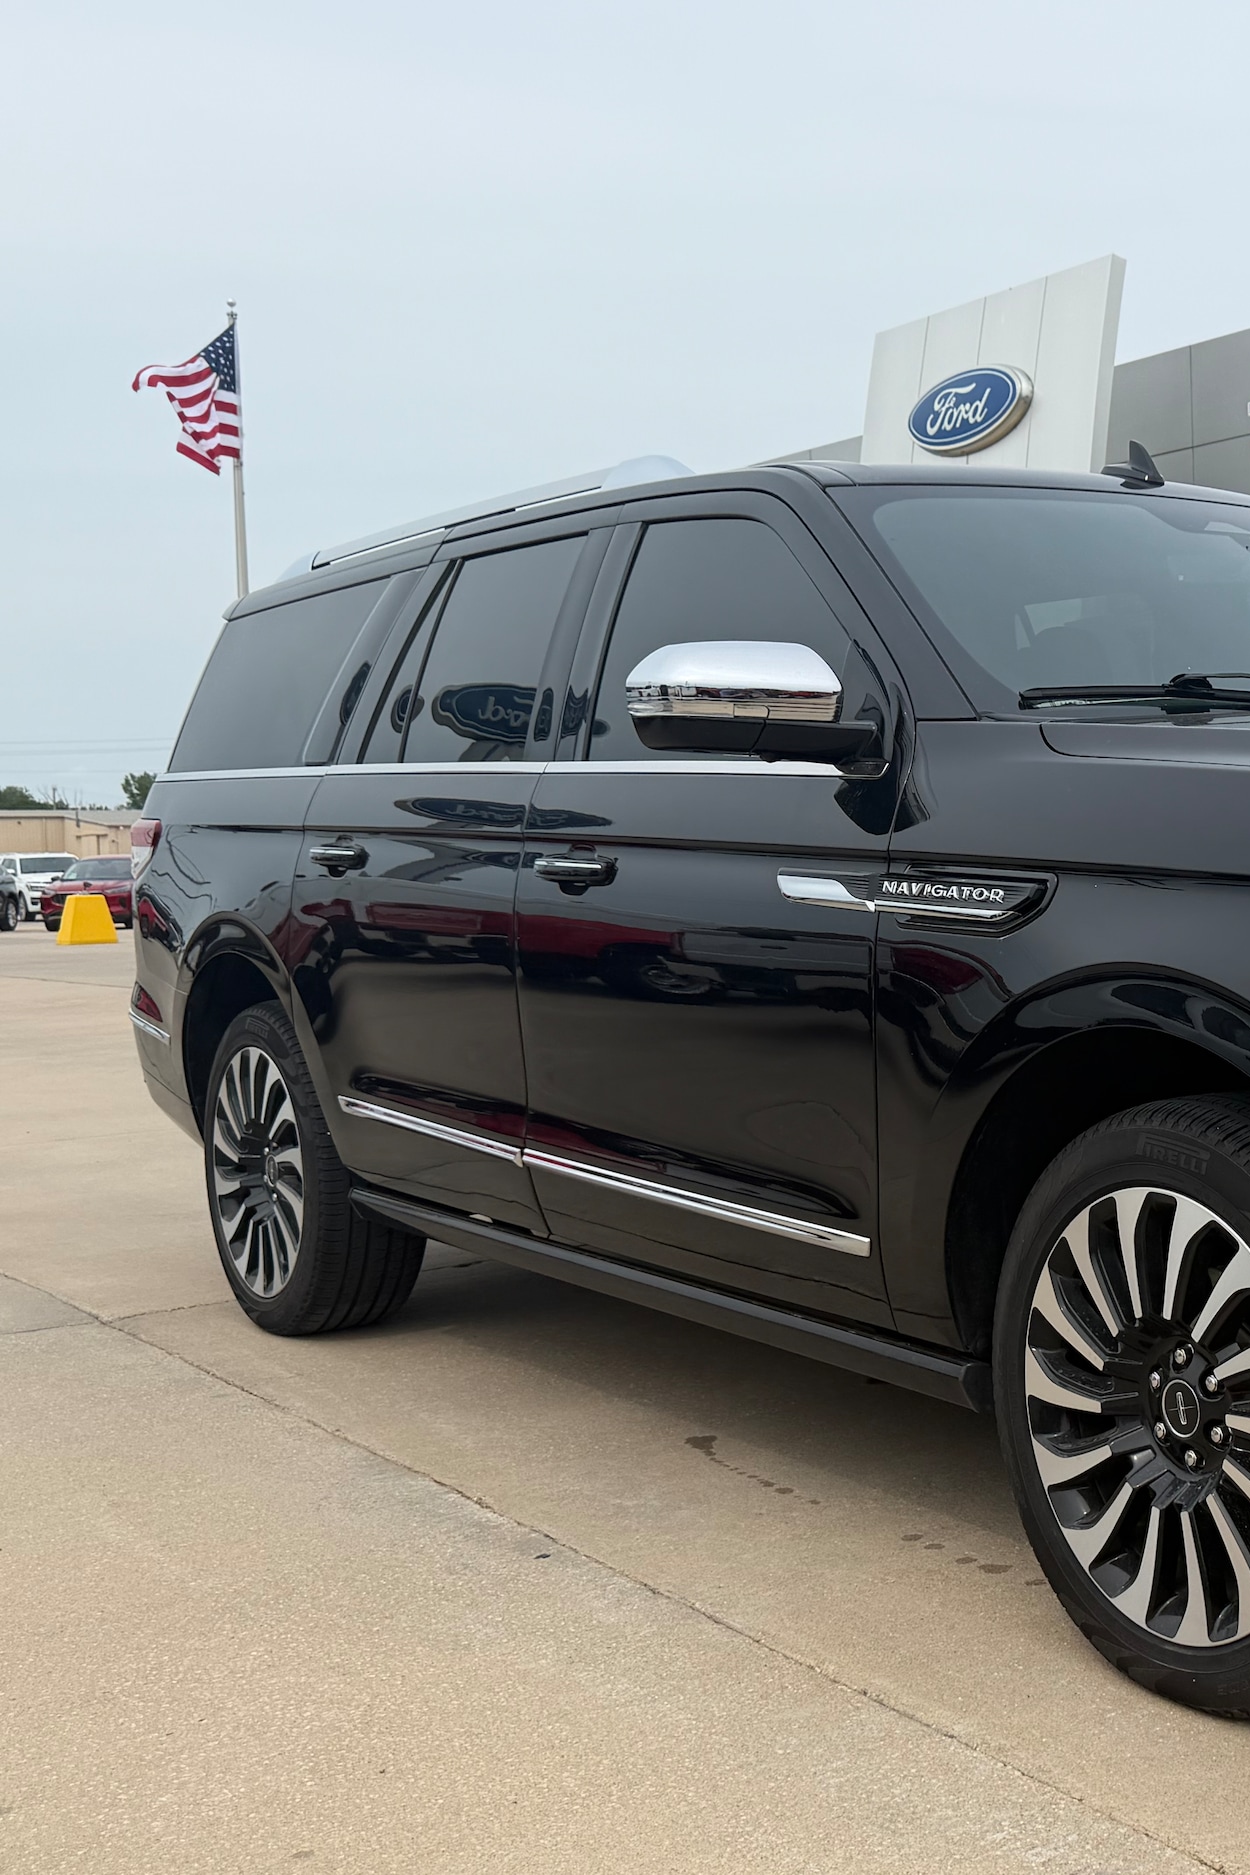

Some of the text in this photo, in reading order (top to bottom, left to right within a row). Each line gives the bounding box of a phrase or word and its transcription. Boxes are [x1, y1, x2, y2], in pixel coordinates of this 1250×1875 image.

[926, 382, 992, 436] Ford
[881, 880, 1004, 904] NAVIGATOR
[1135, 1131, 1211, 1176] PIRELLI
